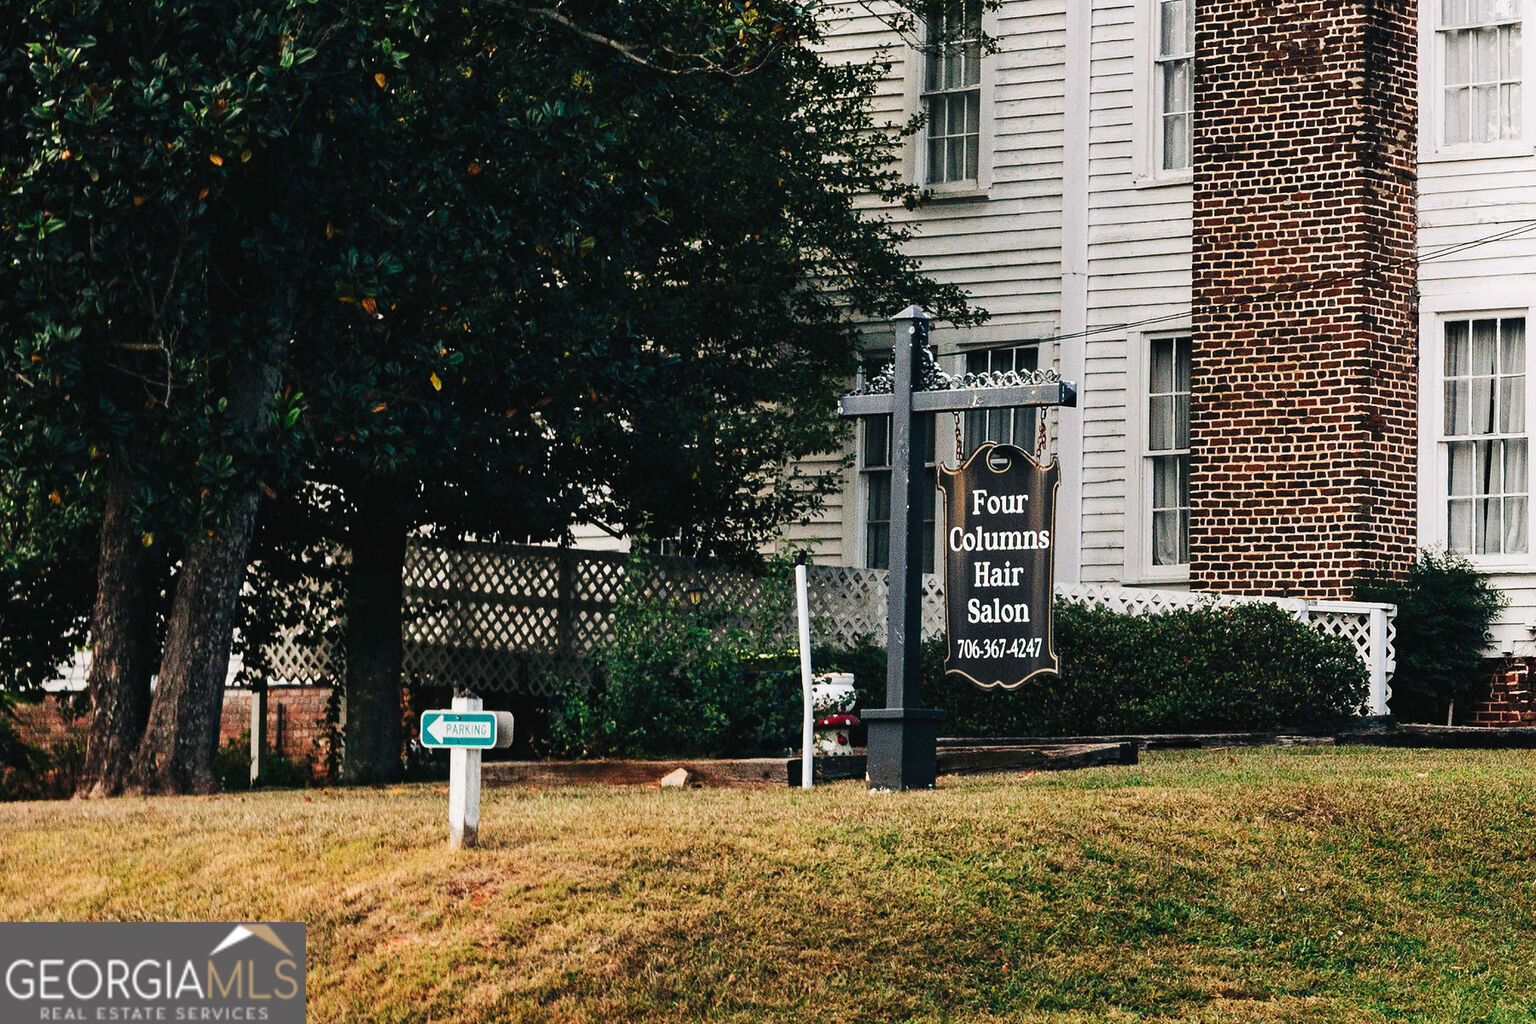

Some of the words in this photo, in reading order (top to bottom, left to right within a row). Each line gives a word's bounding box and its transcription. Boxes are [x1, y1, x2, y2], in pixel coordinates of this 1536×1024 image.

[972, 489, 1029, 516] Four
[949, 525, 1050, 553] Columns
[973, 560, 1024, 588] Hair
[967, 597, 1031, 624] Salon
[957, 637, 1043, 659] 706-367-4247
[446, 723, 487, 736] PARKING
